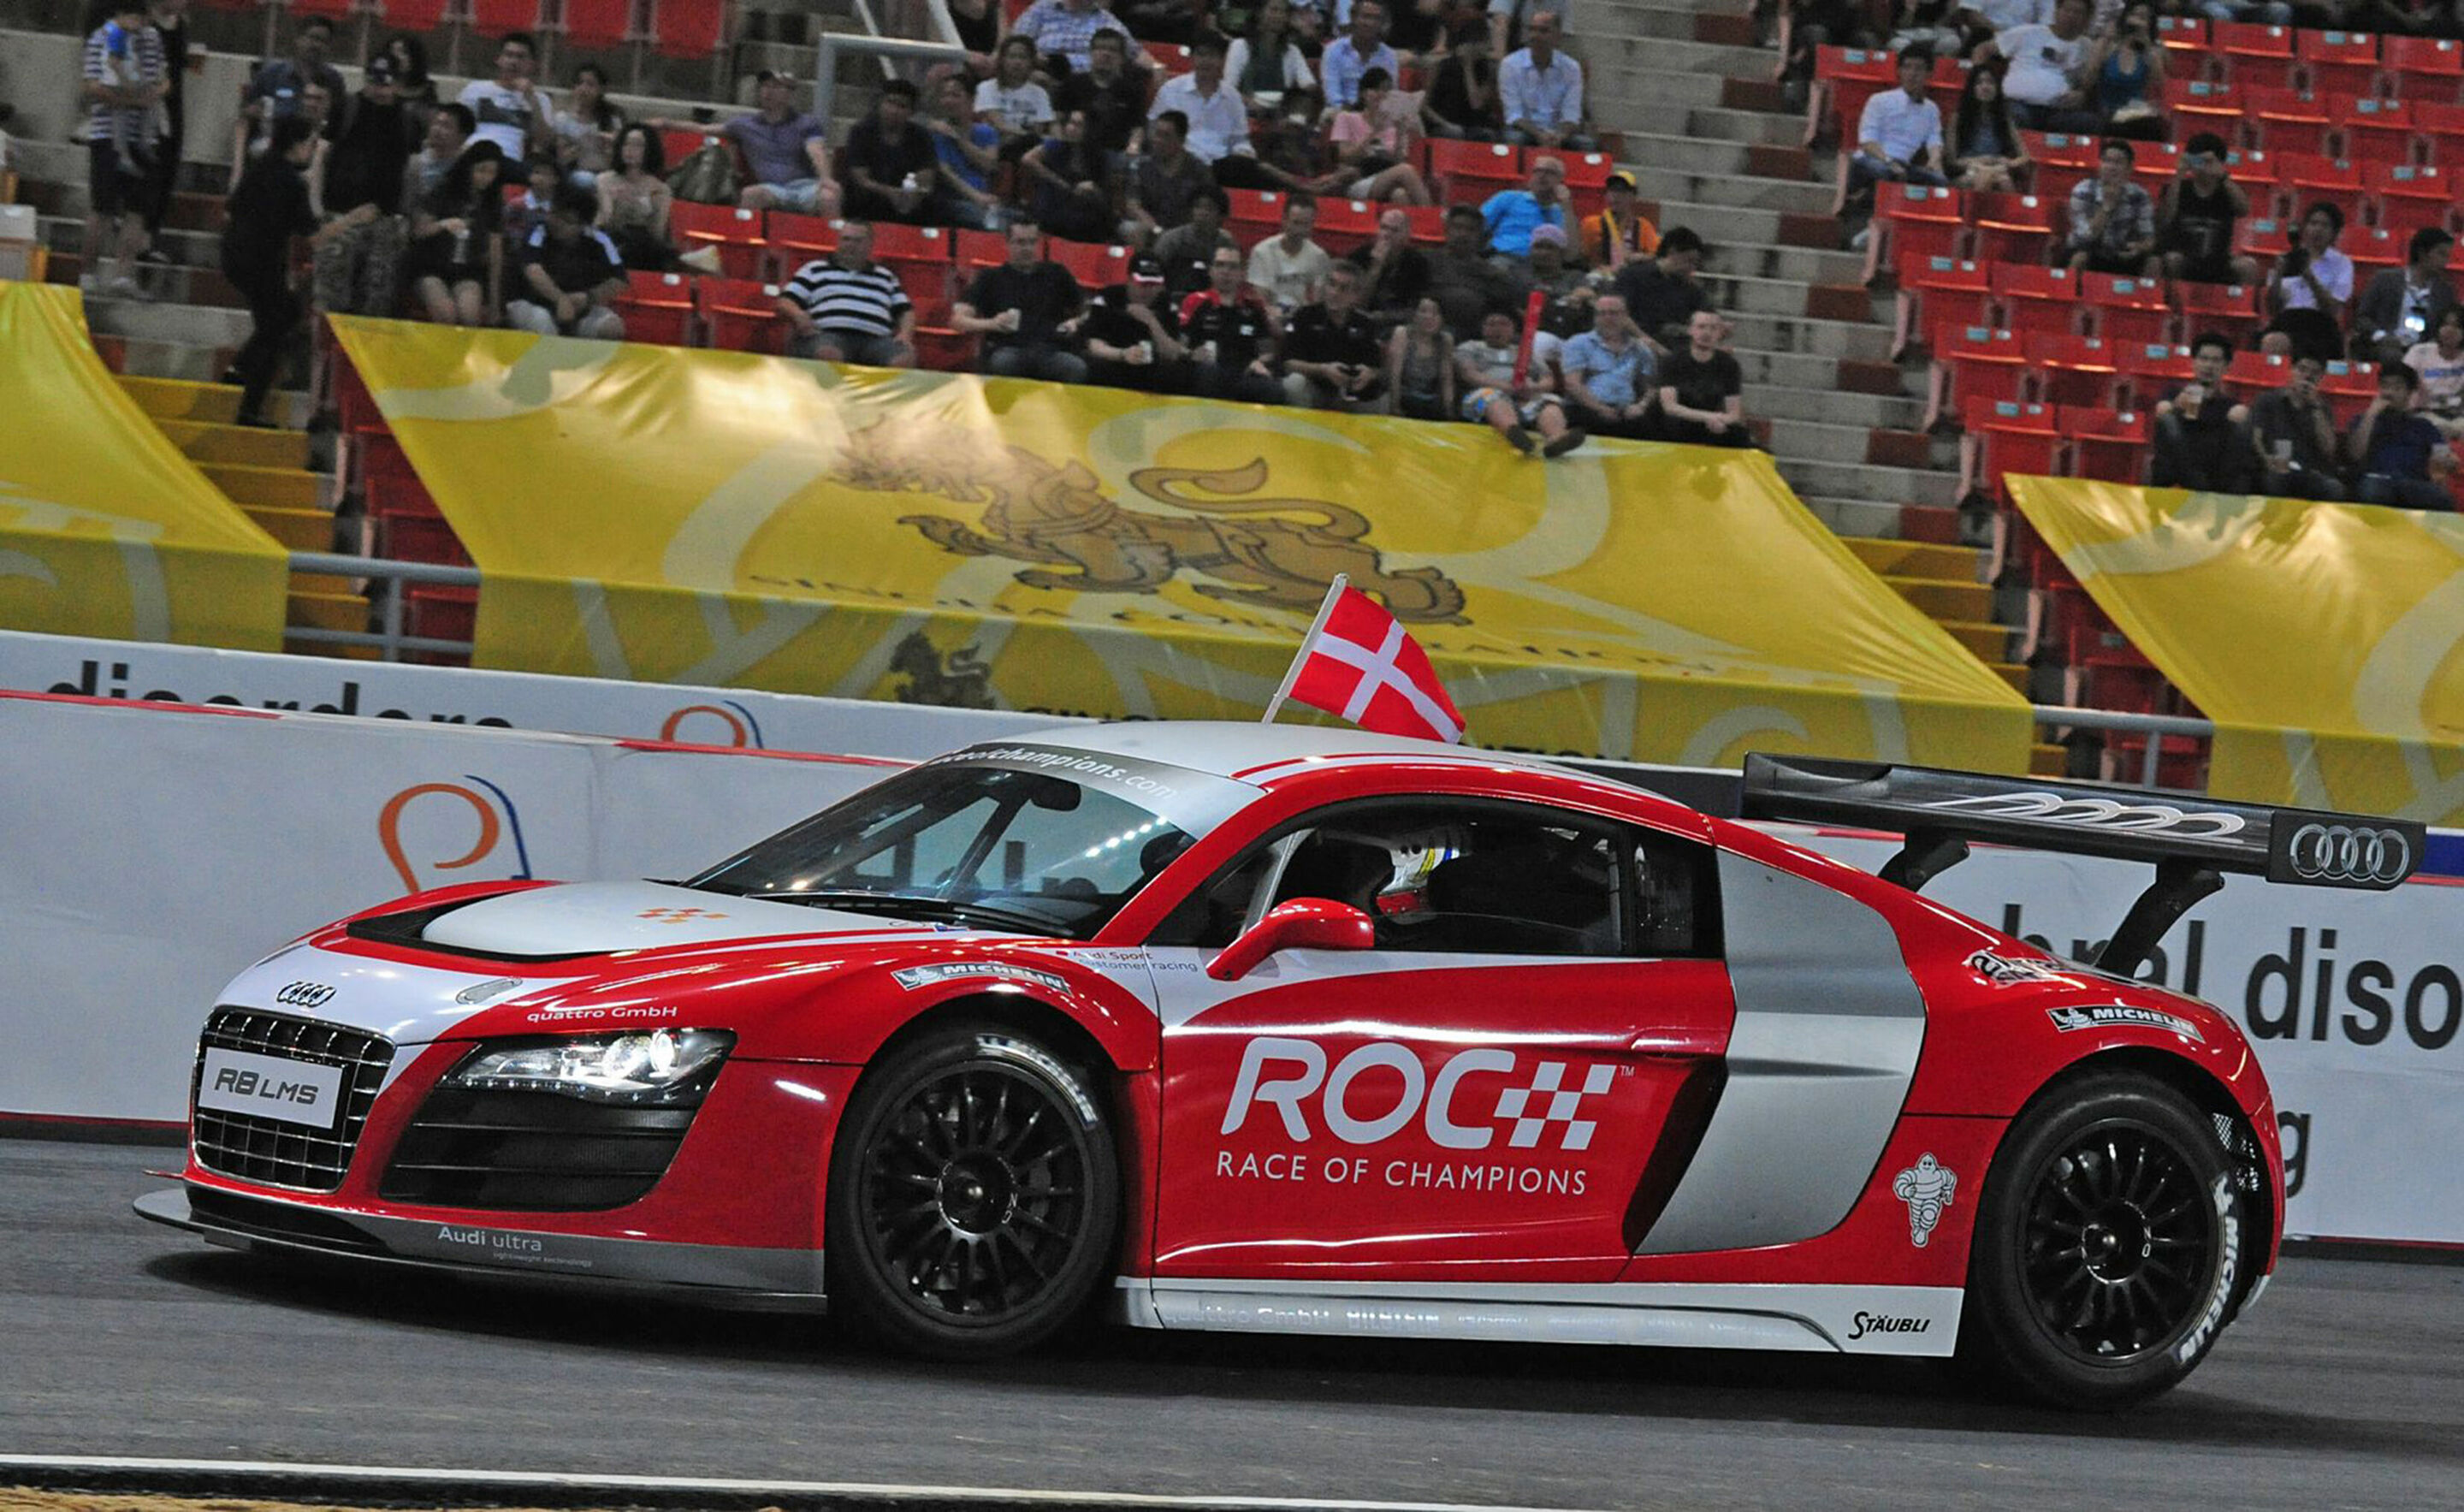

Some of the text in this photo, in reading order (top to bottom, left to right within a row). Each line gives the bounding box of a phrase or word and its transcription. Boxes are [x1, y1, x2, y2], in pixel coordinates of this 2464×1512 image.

[1073, 951, 1155, 962] Adi Sport
[1152, 961, 1199, 973] racing
[942, 964, 1063, 988] MICHELIN
[526, 1005, 678, 1023] quattro GmbH
[2093, 1007, 2195, 1034] MICHELIN
[214, 1067, 319, 1106] R8 LMS
[1220, 1036, 1517, 1150] ROC
[1215, 1150, 1587, 1195] RACE OF CHAMPIONS
[437, 1225, 542, 1252] Audi ultra
[2179, 1215, 2239, 1364] MICHELIN
[1847, 1310, 1931, 1341] STÄUBLI
